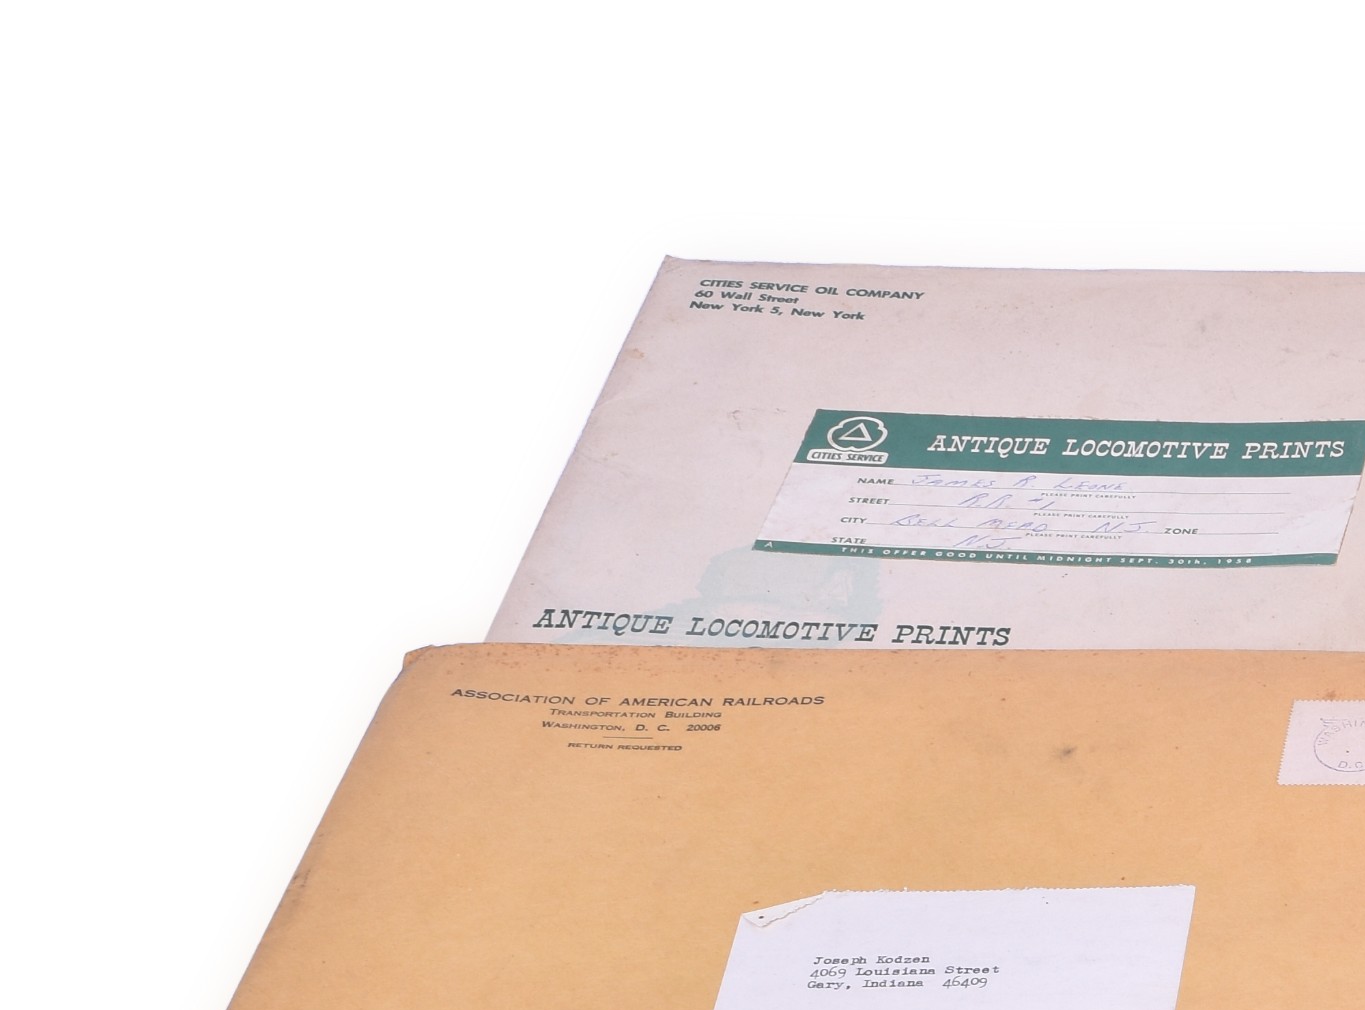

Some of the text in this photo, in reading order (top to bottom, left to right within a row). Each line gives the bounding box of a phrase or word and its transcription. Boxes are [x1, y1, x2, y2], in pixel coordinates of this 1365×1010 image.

[699, 280, 925, 299] CITIES SERVICE OIL COMPANY
[927, 435, 1344, 459] ANTIQUE LOCOMOTIVE PRINTS
[811, 452, 884, 462] CITIES SERVICE
[532, 609, 1010, 646] ANTIQUE LOCOMOTIVE PRINTS
[451, 689, 825, 706] ASSOCIATION OF AMERICAN RAILROADS
[813, 956, 867, 965] Joseph
[809, 966, 1000, 977] 4069 Louisiana Street
[807, 981, 851, 990] Gary,
[941, 976, 988, 988] 46409
